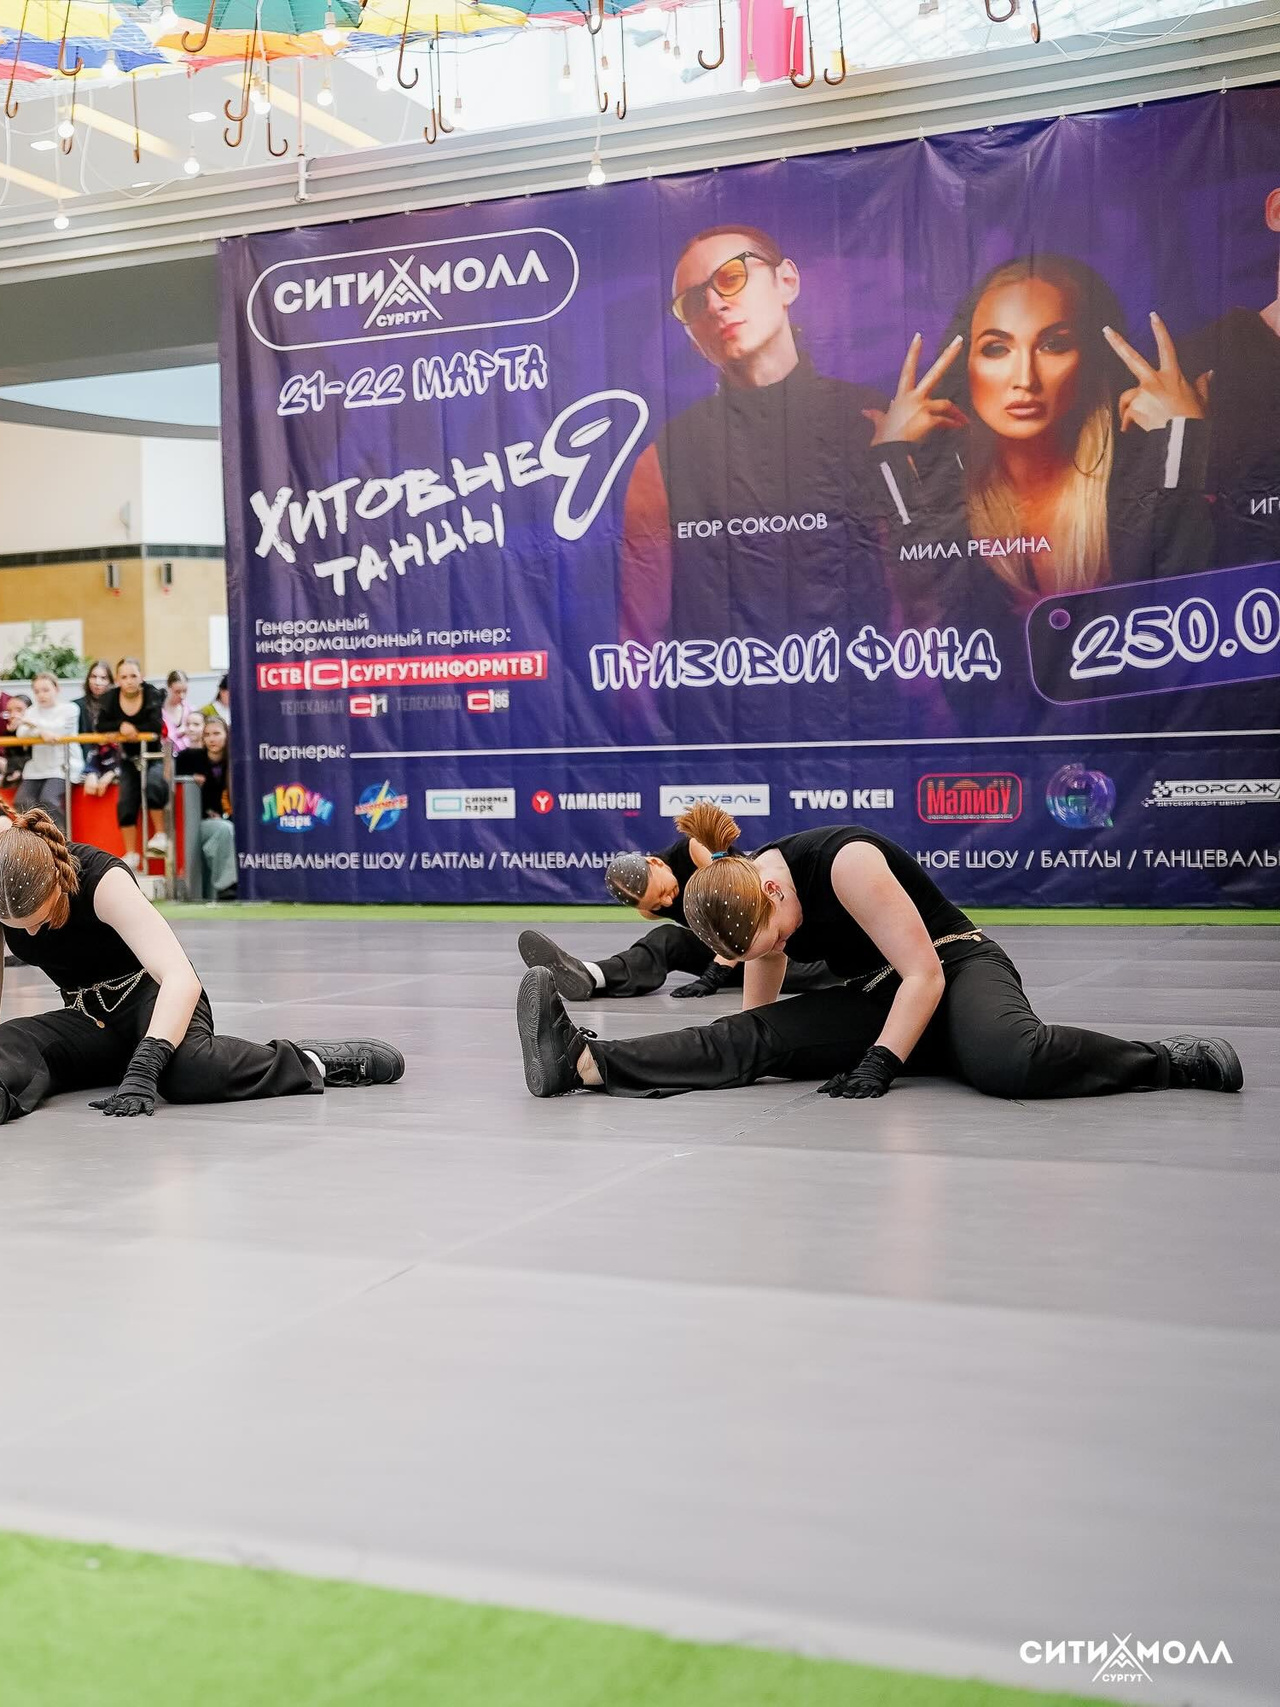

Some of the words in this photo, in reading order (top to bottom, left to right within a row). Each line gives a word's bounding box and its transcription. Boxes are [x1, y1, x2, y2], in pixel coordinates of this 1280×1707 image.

[273, 269, 385, 315] СИТИ
[420, 249, 550, 299] МОЛЛ
[376, 310, 430, 328] СУРГУТ
[276, 363, 406, 417] 21-22
[412, 343, 549, 402] МАРТА
[677, 520, 723, 539] ЕГОР
[726, 512, 828, 536] СОКОЛОВ
[314, 503, 505, 596] ТАНЦЫ
[899, 542, 961, 561] МИЛА
[968, 535, 1052, 557] РЕДИНА
[255, 613, 370, 637] Генеральный
[255, 628, 422, 654] информационный
[426, 628, 512, 647] партнер:
[589, 626, 841, 692] ПРИЗОВОЙ
[846, 624, 1002, 682] ФОНД
[258, 743, 346, 762] Партнеры:
[789, 789, 849, 811] TWO
[853, 789, 894, 809] KEI
[1175, 783, 1276, 794] ФОРСАЖ
[558, 792, 641, 810] YAMAGUCHI
[238, 852, 360, 870] ТАНЦЕВАЛЬНОЕ
[363, 852, 406, 869] ШОУ
[421, 852, 484, 870] БАТТЛЫ
[501, 851, 640, 870] ТАНЦЕВАЛЬН
[965, 850, 1018, 868] ШОУ
[1041, 849, 1121, 868] БАТТЛЫ
[1142, 849, 1280, 869] ТАНЦЕВАЛЬ
